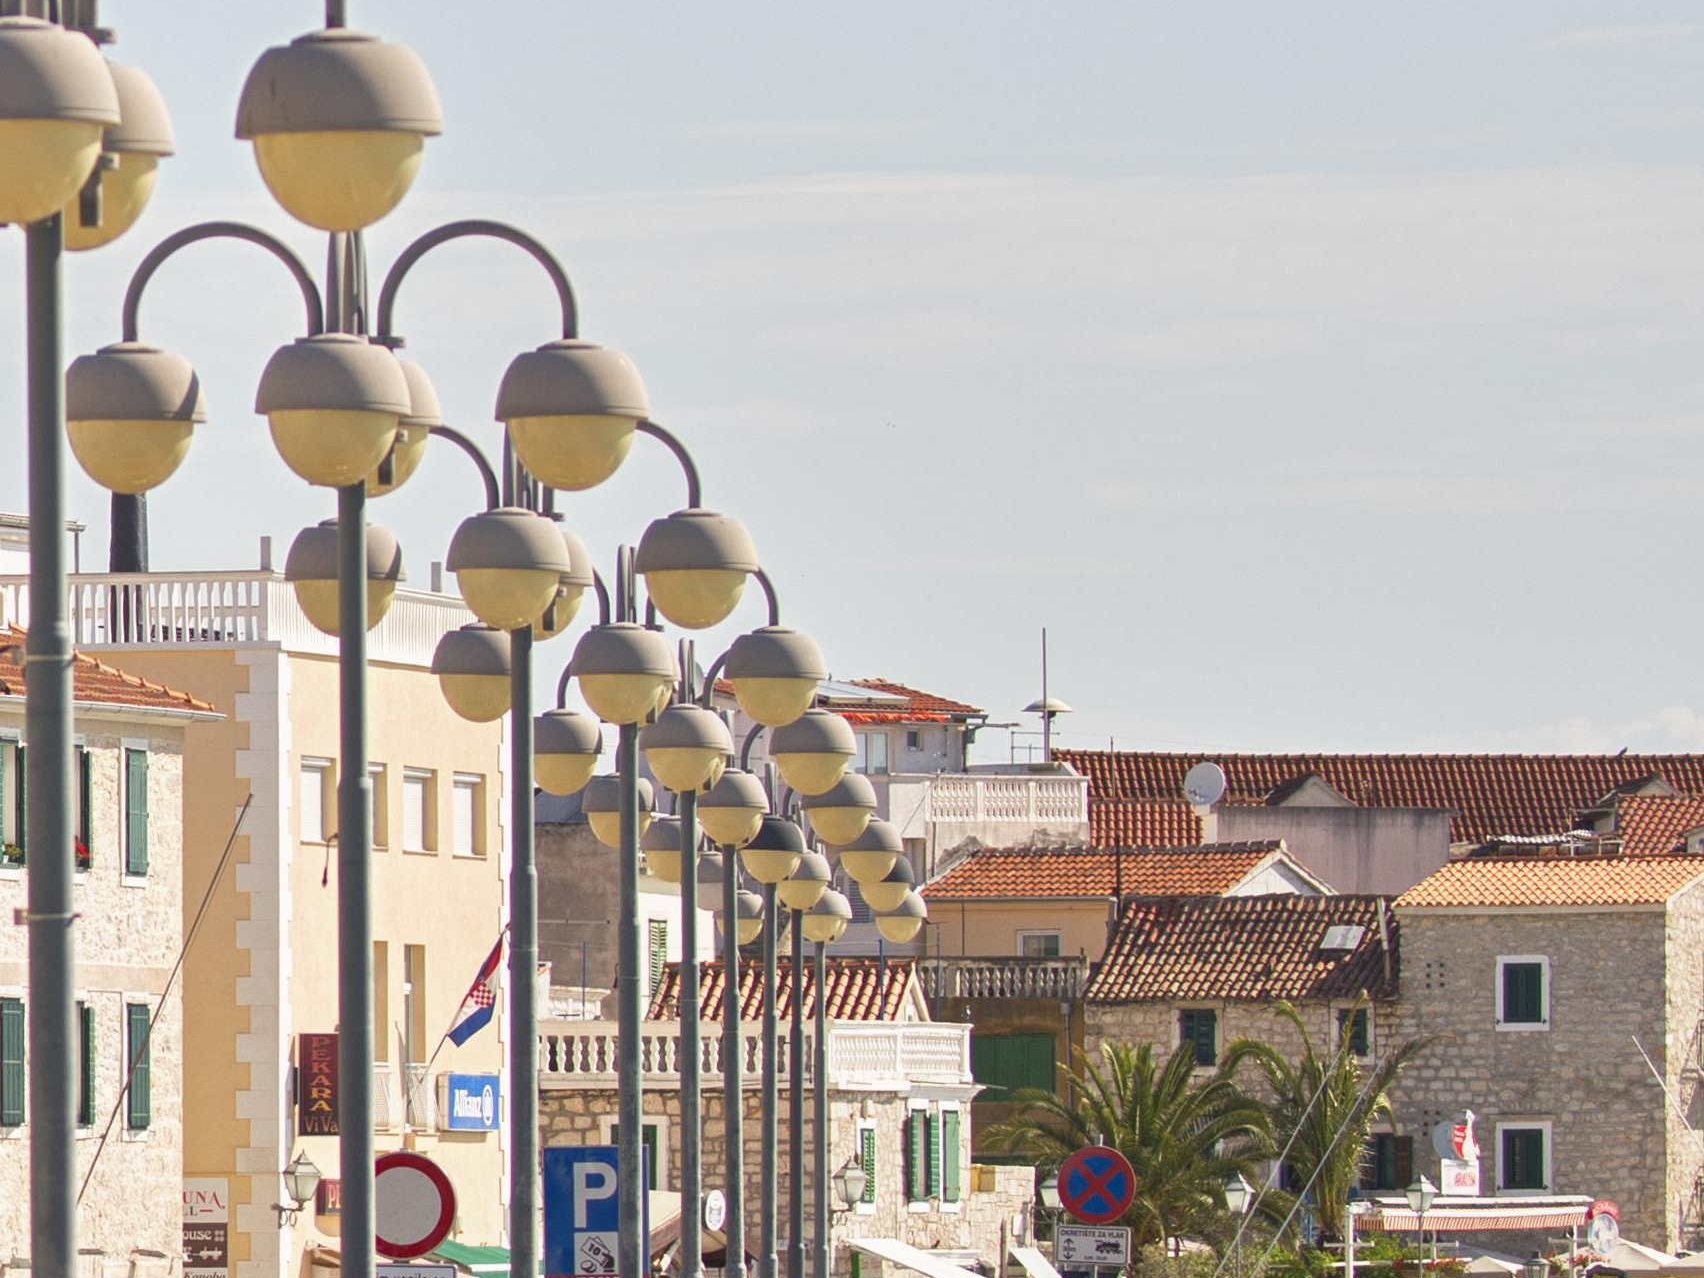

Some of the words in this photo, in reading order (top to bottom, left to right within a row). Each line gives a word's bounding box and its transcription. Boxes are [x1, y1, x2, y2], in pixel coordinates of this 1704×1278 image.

[309, 1036, 333, 1111] PEKARA
[183, 1191, 225, 1209] UNA
[183, 1230, 212, 1240] ouse
